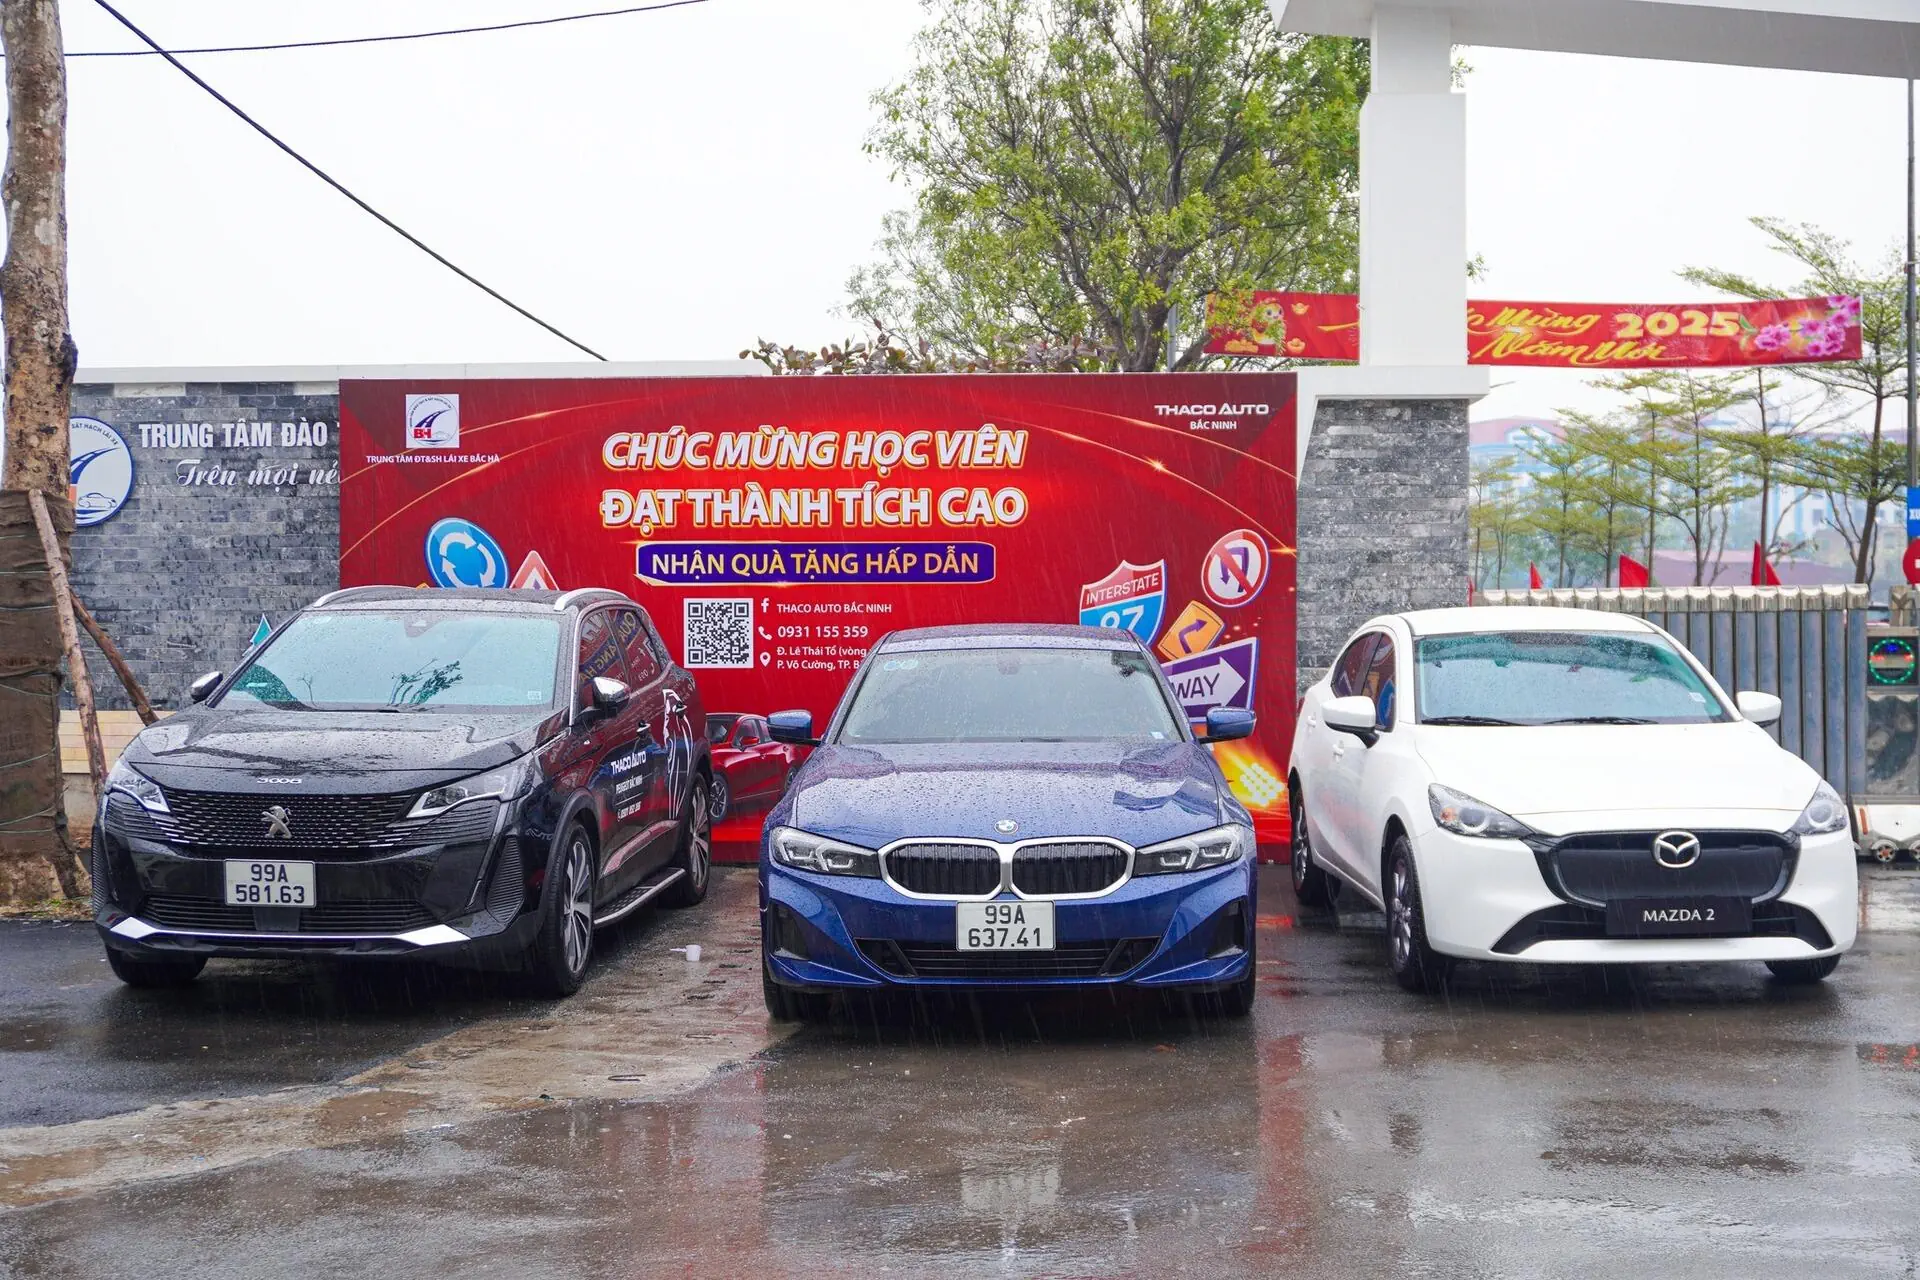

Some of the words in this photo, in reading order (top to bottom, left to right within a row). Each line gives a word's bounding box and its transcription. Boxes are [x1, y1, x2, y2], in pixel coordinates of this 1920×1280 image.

[1616, 311, 1740, 338] 2025
[1154, 404, 1216, 415] THACO
[1218, 403, 1270, 415] AUTO
[138, 423, 214, 448] TRUNG
[222, 418, 272, 447] TÂM
[281, 417, 328, 448] ĐÀO
[1190, 418, 1211, 431] BẮC
[1211, 420, 1237, 430] NINH
[366, 455, 394, 464] TRUNG
[396, 454, 413, 463] TÂM
[414, 455, 443, 464] ĐT&SH
[443, 453, 457, 463] LÁI
[458, 454, 469, 463] XE
[470, 453, 487, 463] BẮC
[487, 453, 500, 463] HÀ
[603, 426, 713, 469] CHÚC
[714, 426, 839, 469] MỪNG
[842, 430, 932, 477] HỌC
[935, 424, 1028, 469] VIÊN
[176, 458, 237, 486] Trên
[248, 463, 299, 492] mọi
[600, 488, 683, 536] ĐẠT
[686, 482, 831, 528] THÀNH
[835, 481, 932, 528] TÍCH
[938, 487, 1029, 528] CAO
[651, 550, 725, 580] NHẬN
[731, 549, 787, 577] QUÀ
[790, 548, 858, 580] TẶNG
[866, 546, 918, 575] HẤP
[924, 545, 979, 574] DẪN
[1086, 571, 1160, 605] INTERSTATE
[776, 603, 811, 613] THACO
[813, 603, 842, 613] AUTO
[843, 601, 865, 613] BẮC
[865, 603, 892, 613] NINH
[777, 625, 810, 638] 0931
[815, 625, 840, 638] 155
[843, 625, 868, 638] 359
[776, 646, 788, 656] Đ.
[789, 646, 801, 656] Lê
[802, 646, 824, 656] Thái
[825, 645, 837, 656] Tổ
[838, 646, 867, 660] (vòng
[777, 660, 785, 669] P.
[786, 659, 800, 669] Võ
[801, 659, 836, 672] Cường,
[838, 660, 852, 669] TP.
[853, 660, 861, 669] B
[1171, 672, 1220, 699] WAY
[611, 756, 631, 775] THACO
[632, 751, 646, 768] AUTO
[251, 864, 288, 882] 99A
[236, 885, 305, 904] 581.63
[985, 904, 1026, 925] 99A
[1643, 908, 1702, 922] MAZDA
[1705, 908, 1715, 921] 2
[968, 927, 1041, 948] 637.41
